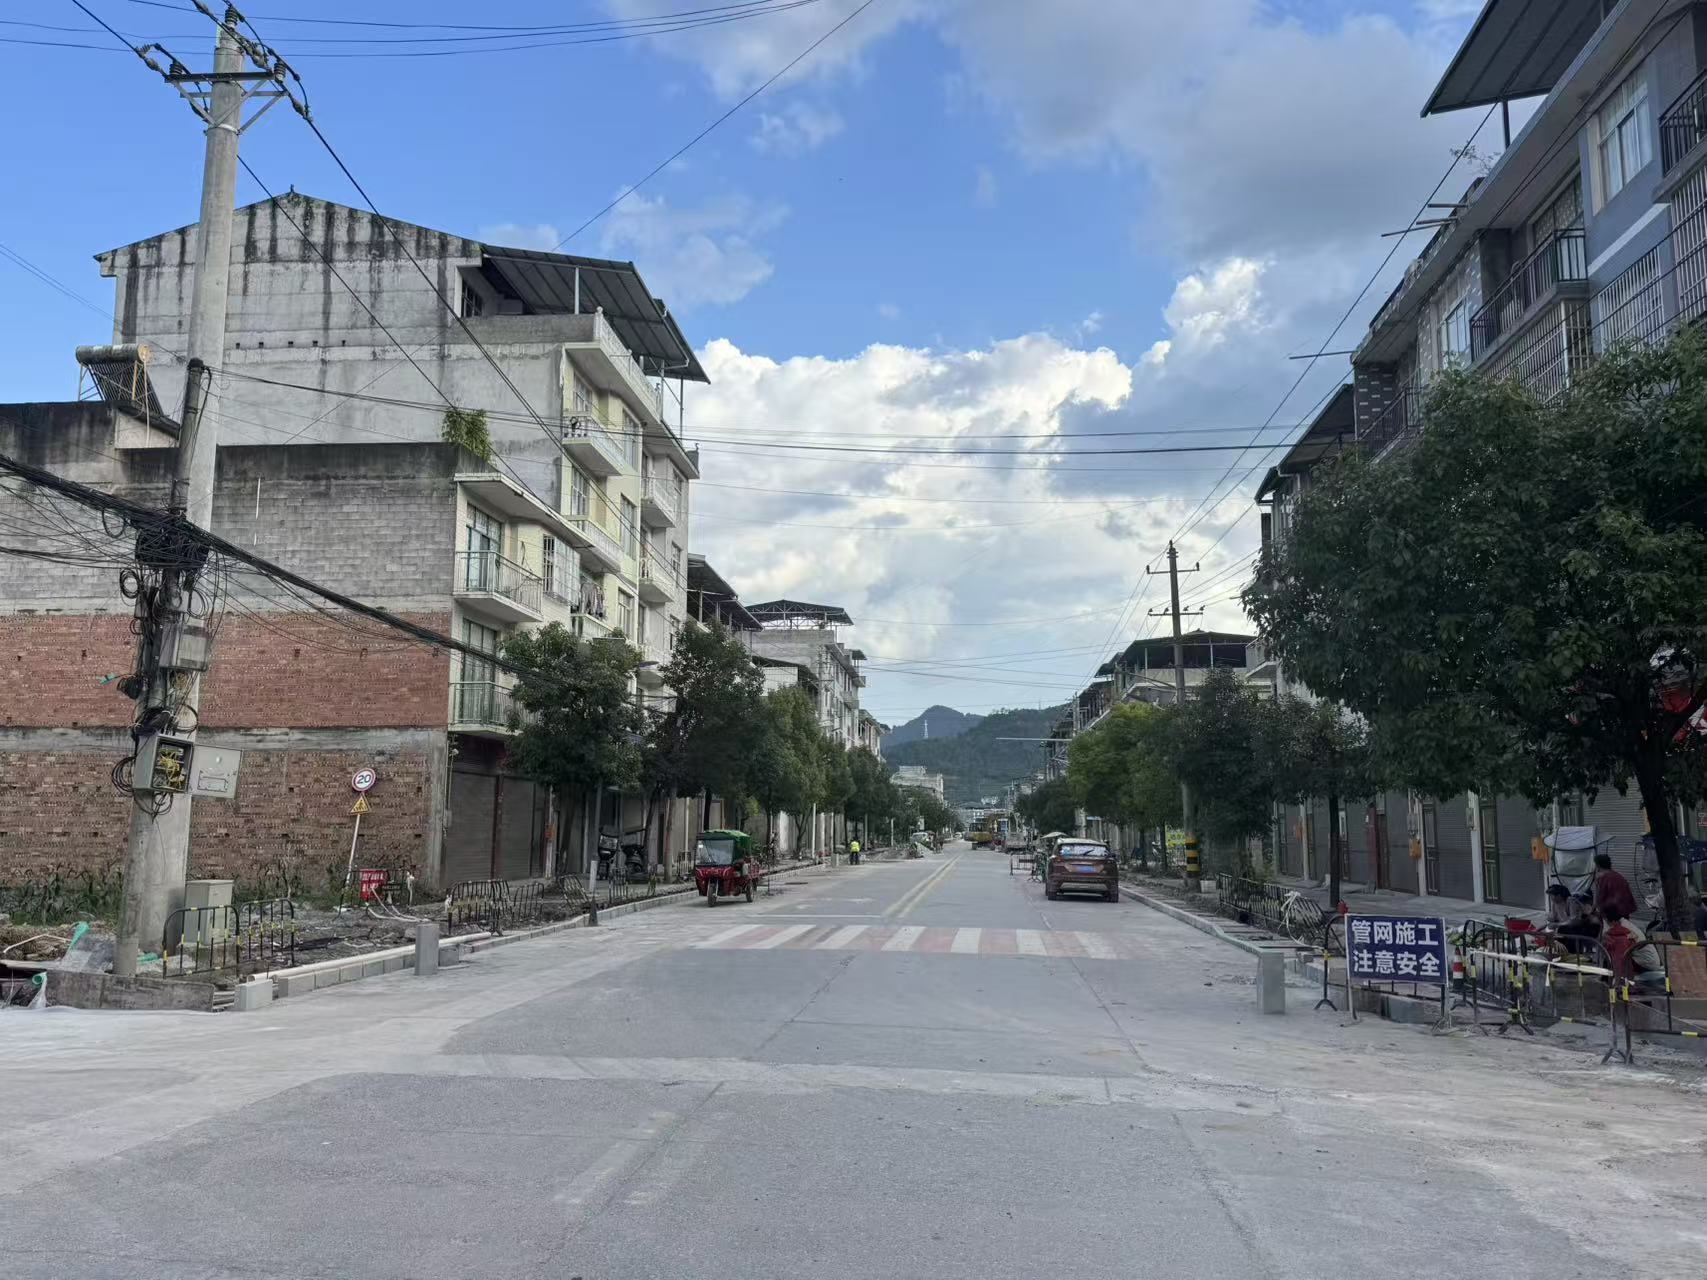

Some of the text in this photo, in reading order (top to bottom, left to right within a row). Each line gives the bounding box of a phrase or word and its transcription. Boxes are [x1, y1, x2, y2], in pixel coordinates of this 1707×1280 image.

[357, 774, 372, 784] 20
[1351, 920, 1439, 945] 管网施工
[1353, 949, 1441, 976] 注意安全
